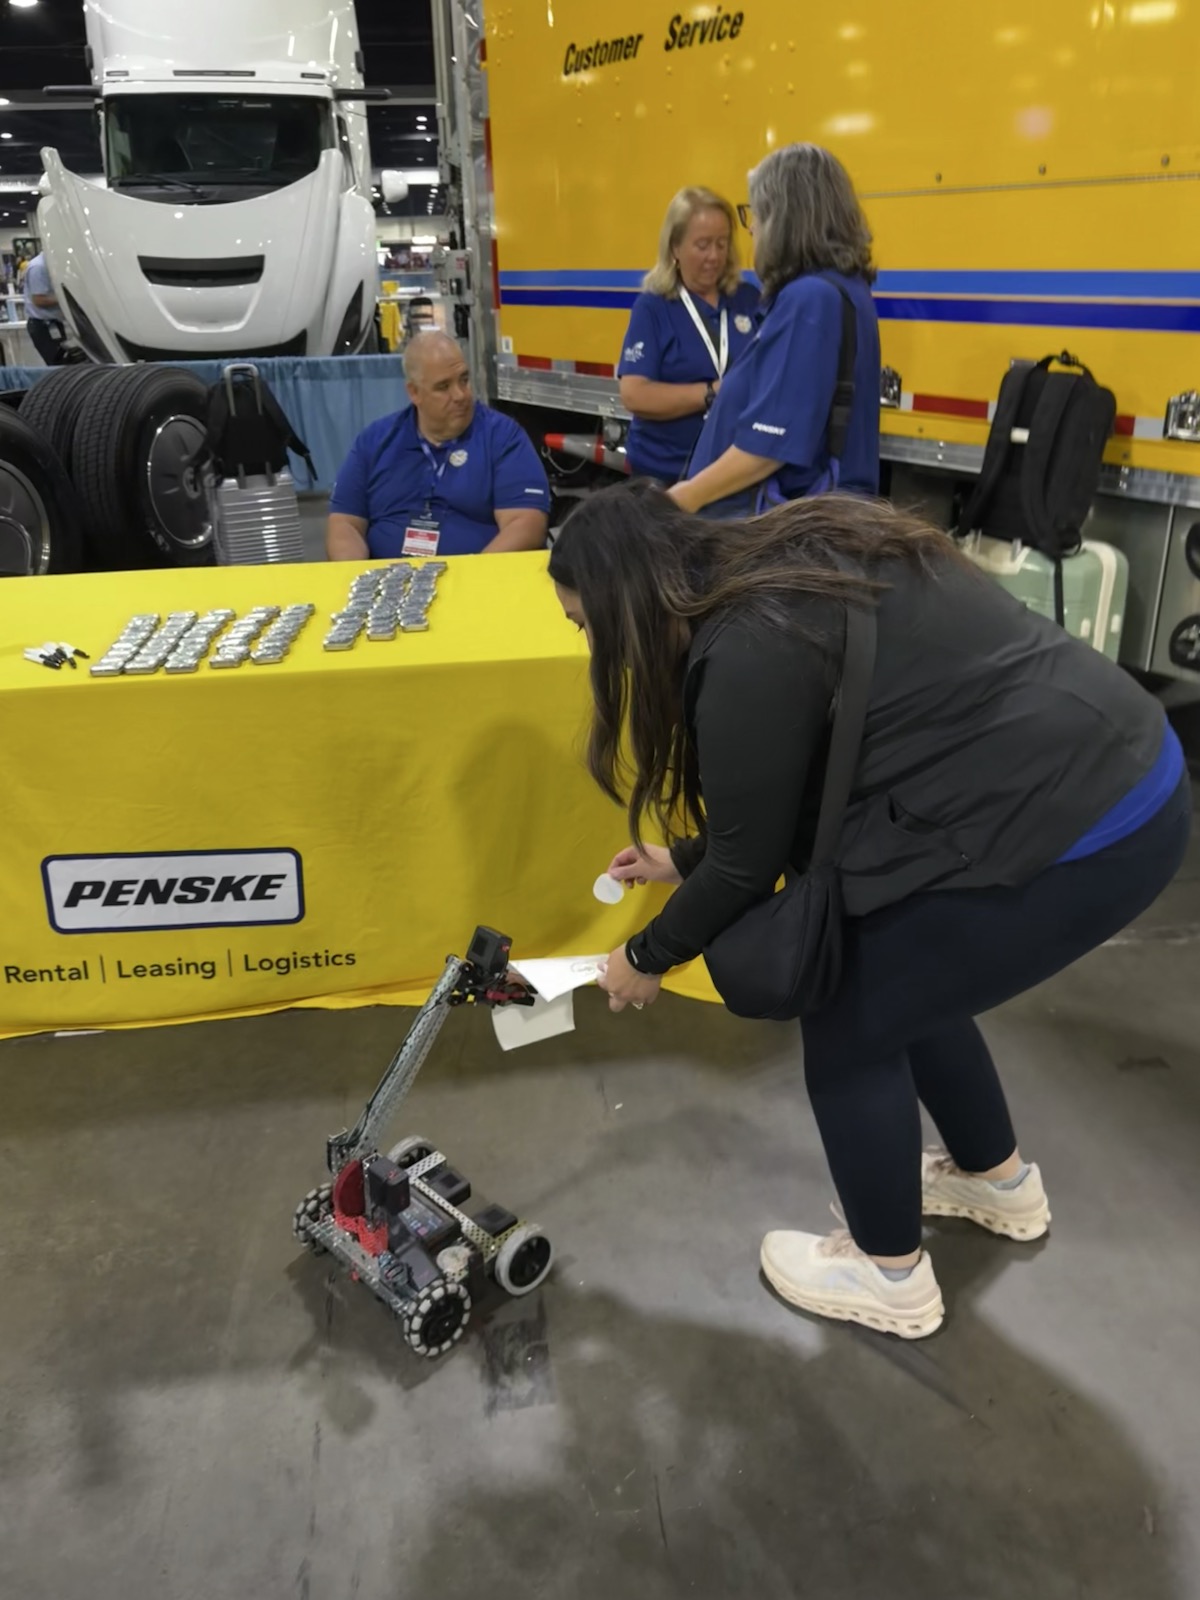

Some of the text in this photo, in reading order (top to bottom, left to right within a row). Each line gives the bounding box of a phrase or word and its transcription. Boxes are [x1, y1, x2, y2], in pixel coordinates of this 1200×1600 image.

[563, 5, 744, 76] Customer Service
[63, 873, 287, 908] PENSKE
[4, 949, 357, 983] Rental Leasing Logistics
